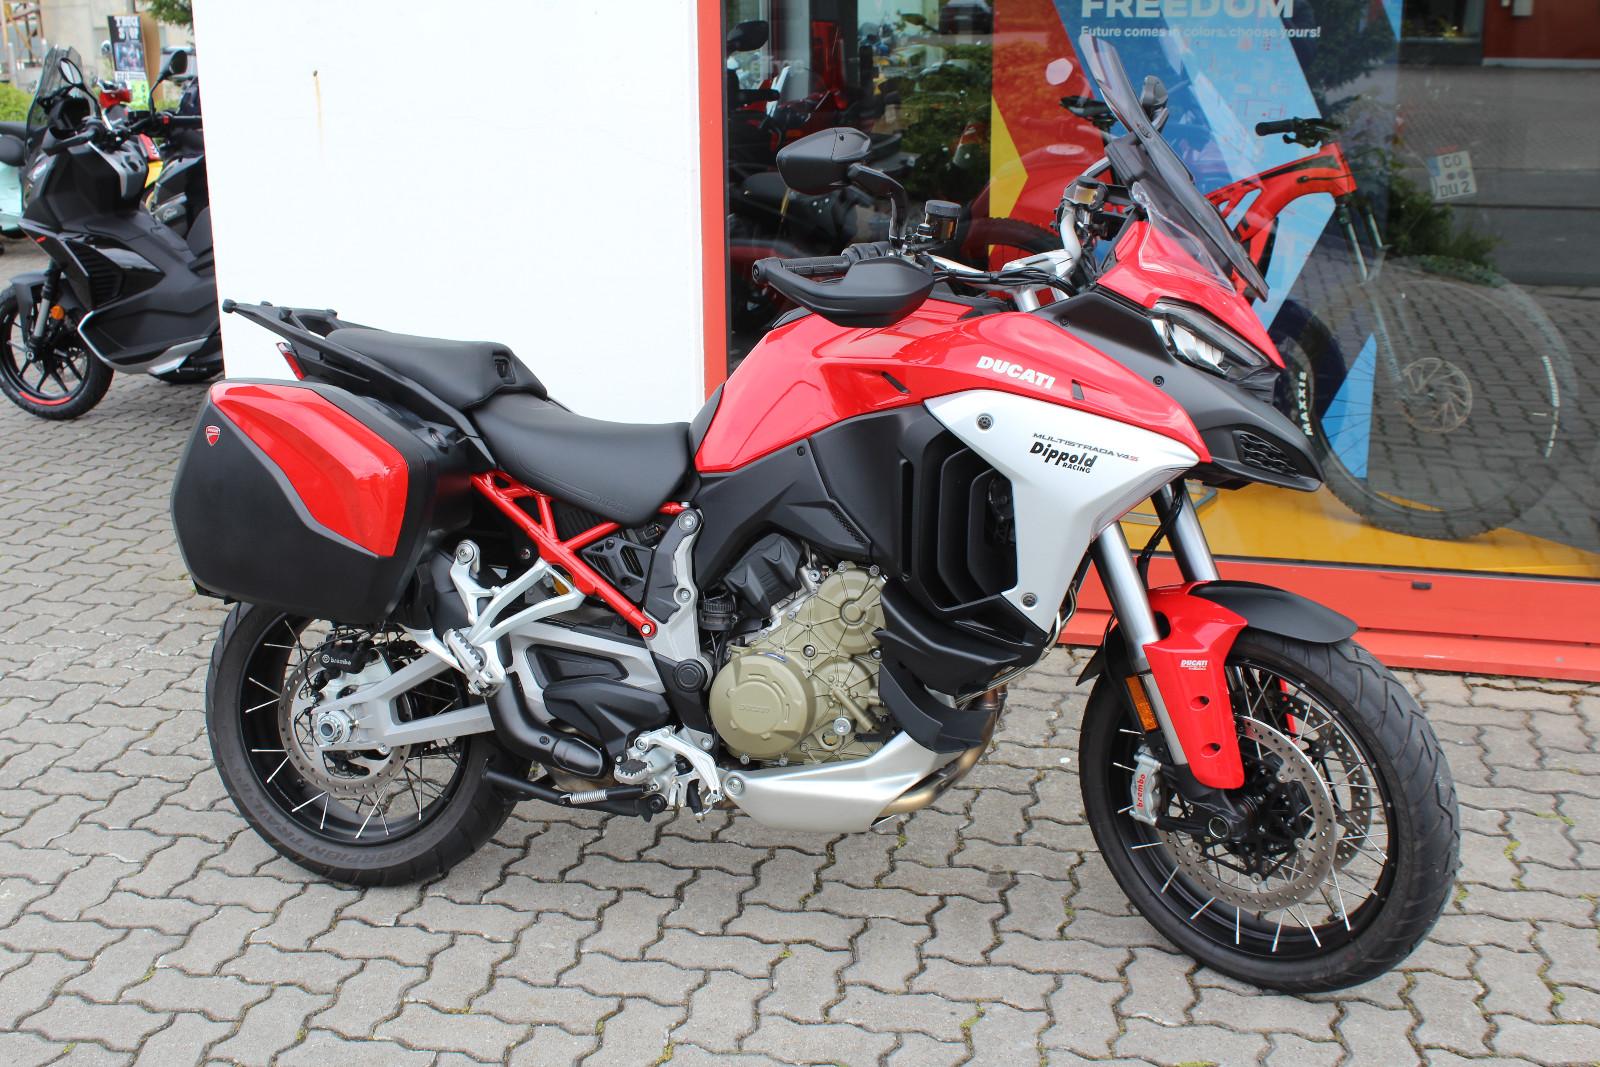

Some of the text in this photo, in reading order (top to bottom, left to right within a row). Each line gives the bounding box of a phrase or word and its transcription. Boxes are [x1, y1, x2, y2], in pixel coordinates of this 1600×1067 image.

[1081, 0, 1294, 18] FREEDOM
[118, 27, 140, 40] STOP
[1080, 25, 1122, 38] Future
[1124, 28, 1167, 37] comes
[1229, 25, 1278, 38] choose
[1280, 26, 1321, 39] yours!
[1461, 180, 1471, 193] 2
[976, 356, 1056, 389] DUCATI
[1298, 371, 1314, 436] MAXXIS
[1032, 432, 1114, 455] MULTISTRADA
[1029, 441, 1098, 468] Dippold
[1062, 462, 1092, 474] RACING
[1180, 659, 1208, 667] DUCATI
[1136, 773, 1146, 808] brembo
